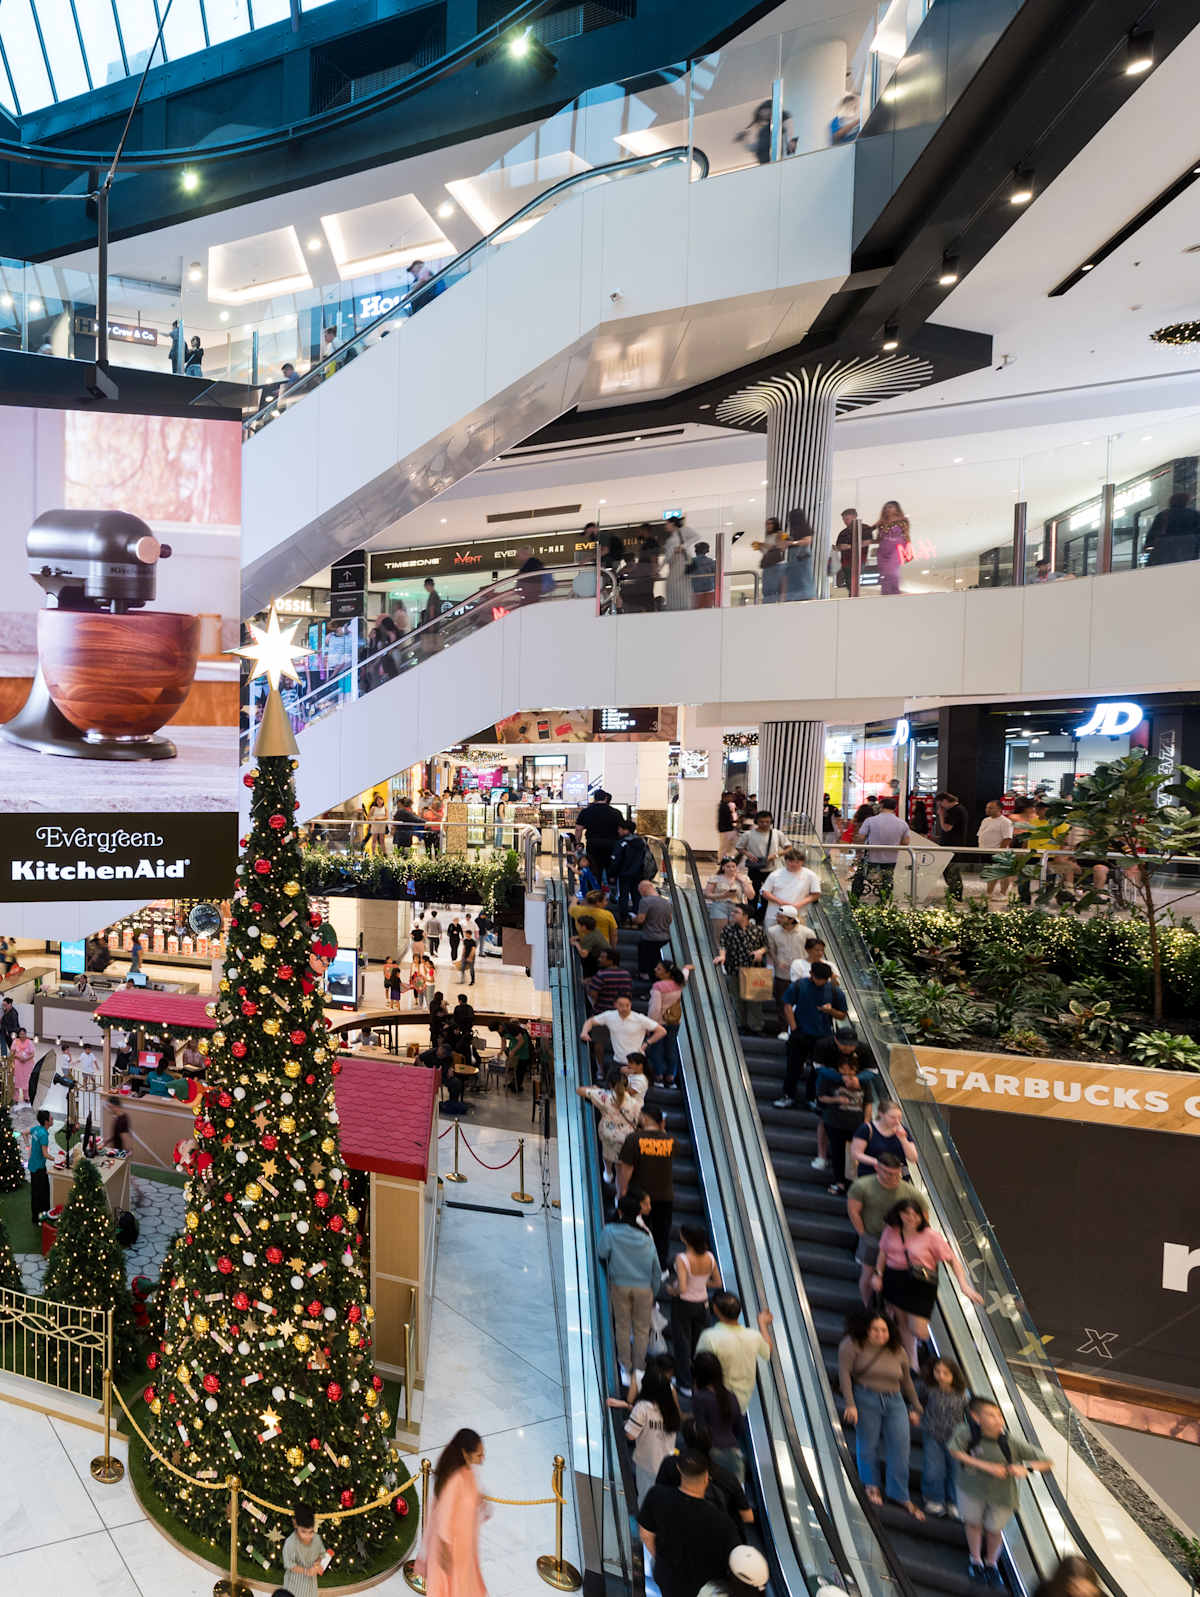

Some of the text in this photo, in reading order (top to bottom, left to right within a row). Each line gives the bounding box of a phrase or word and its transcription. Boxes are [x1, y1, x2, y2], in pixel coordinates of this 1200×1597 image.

[384, 557, 440, 569] TIMEZONE
[274, 599, 313, 613] OSSIL
[892, 719, 910, 746] JD
[1075, 702, 1144, 737] JD
[36, 826, 163, 853] Evergreen
[11, 859, 185, 881] KitchenAid
[915, 1066, 1170, 1113] STARBUCKS
